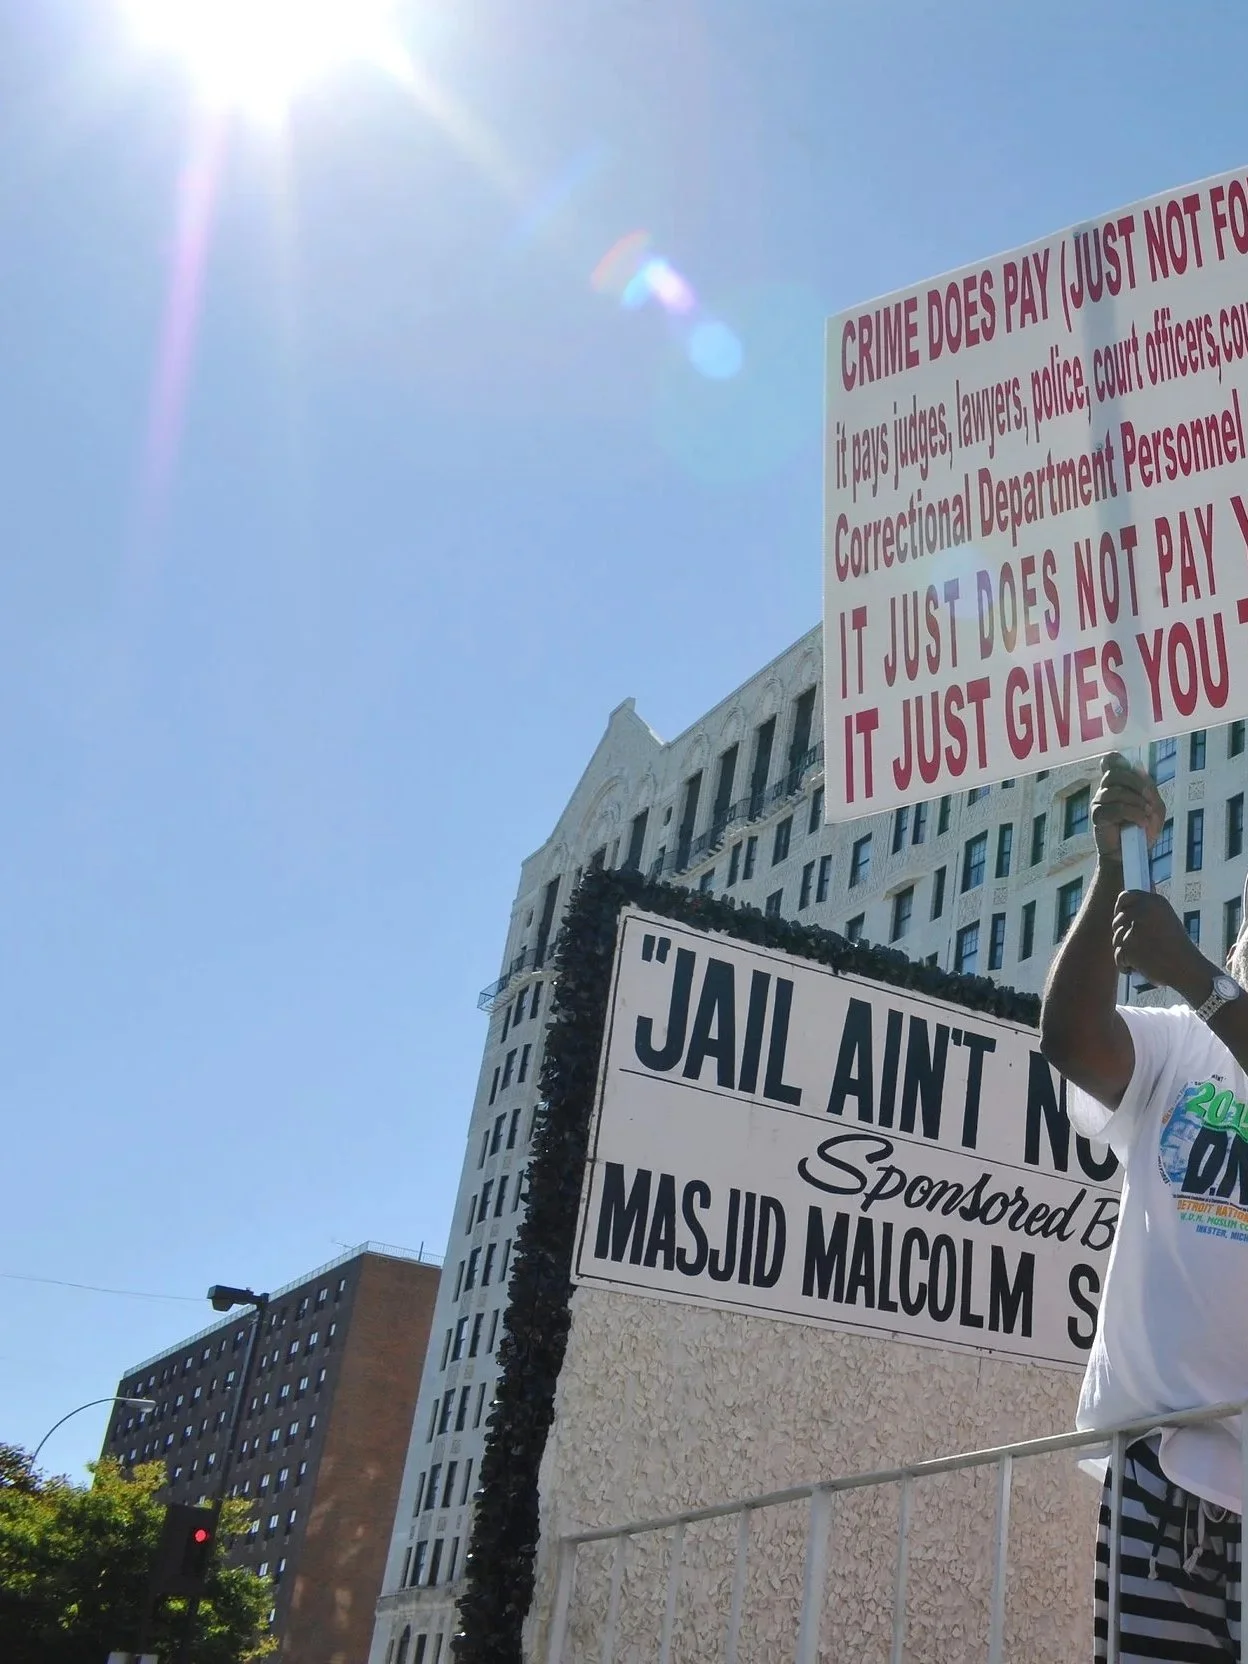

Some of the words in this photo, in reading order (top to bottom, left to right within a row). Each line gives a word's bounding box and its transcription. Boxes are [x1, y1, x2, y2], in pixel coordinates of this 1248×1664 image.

[840, 298, 919, 391] CRIME
[927, 275, 997, 361] DOES
[1003, 248, 1050, 332] PAY
[1060, 215, 1138, 332] (JUST
[1144, 193, 1204, 283] NOT
[835, 473, 972, 582] Correctional
[978, 428, 1117, 547] Department
[1120, 388, 1246, 494] Personnel
[836, 420, 848, 489] it
[852, 422, 889, 503] pays
[893, 394, 953, 490] judges,
[956, 377, 1029, 459] lawyers,
[1032, 345, 1092, 443] police,
[1093, 320, 1143, 402] court
[840, 606, 868, 699] IT
[883, 578, 960, 687] JUST
[976, 548, 1061, 660] DOES
[1073, 524, 1138, 629] NOT
[1154, 503, 1214, 608] PAY
[844, 709, 880, 804] IT
[892, 677, 991, 792] JUST
[1004, 640, 1129, 761] GIVES
[1136, 612, 1230, 724] YOU
[633, 934, 802, 1107] "JAIL
[826, 997, 997, 1150] AIN'T
[594, 1161, 787, 1289] MASJID
[801, 1205, 1036, 1338] MALCOLM
[1067, 1264, 1100, 1350] S
[797, 1133, 1087, 1244] Sponsored
[1080, 1197, 1121, 1251] B
[1177, 1200, 1213, 1214] DETROIT
[1207, 1216, 1238, 1229] MUSLIM
